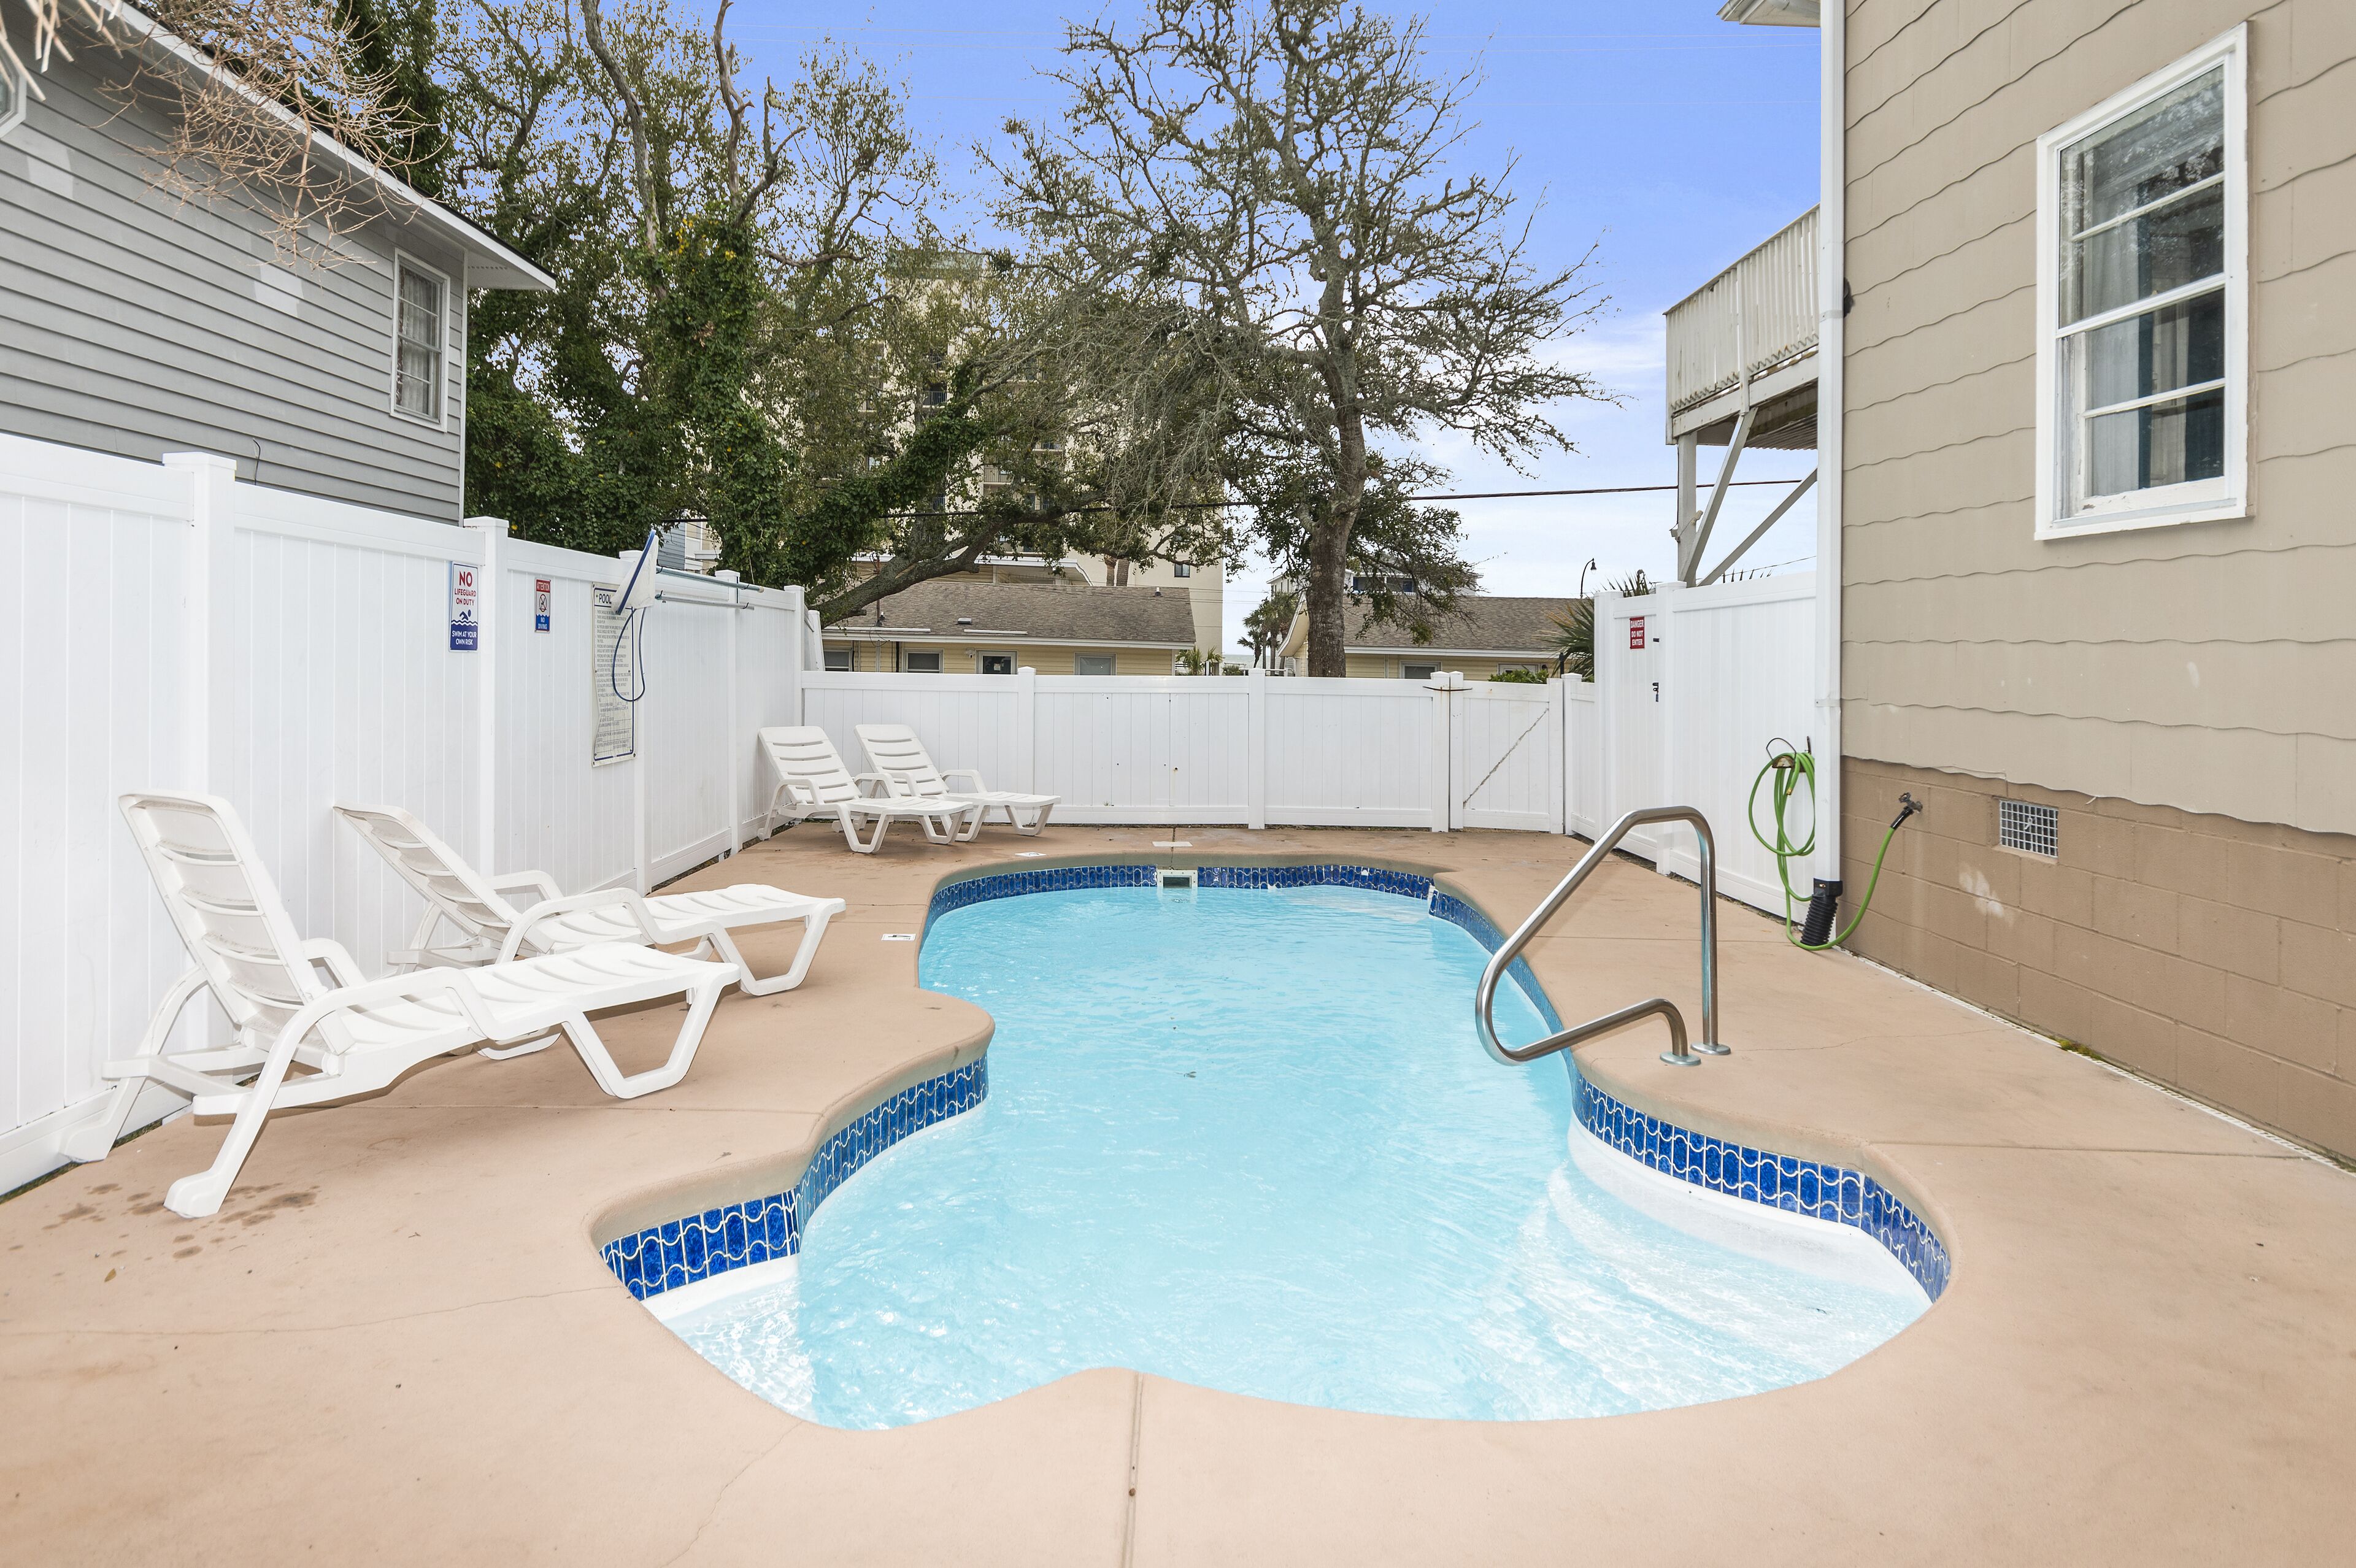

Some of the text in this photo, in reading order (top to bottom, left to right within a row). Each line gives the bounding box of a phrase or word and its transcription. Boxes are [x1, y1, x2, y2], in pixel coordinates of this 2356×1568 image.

[459, 571, 472, 587] NO
[455, 588, 477, 597] LIFEGUARD
[599, 593, 612, 604] POOL
